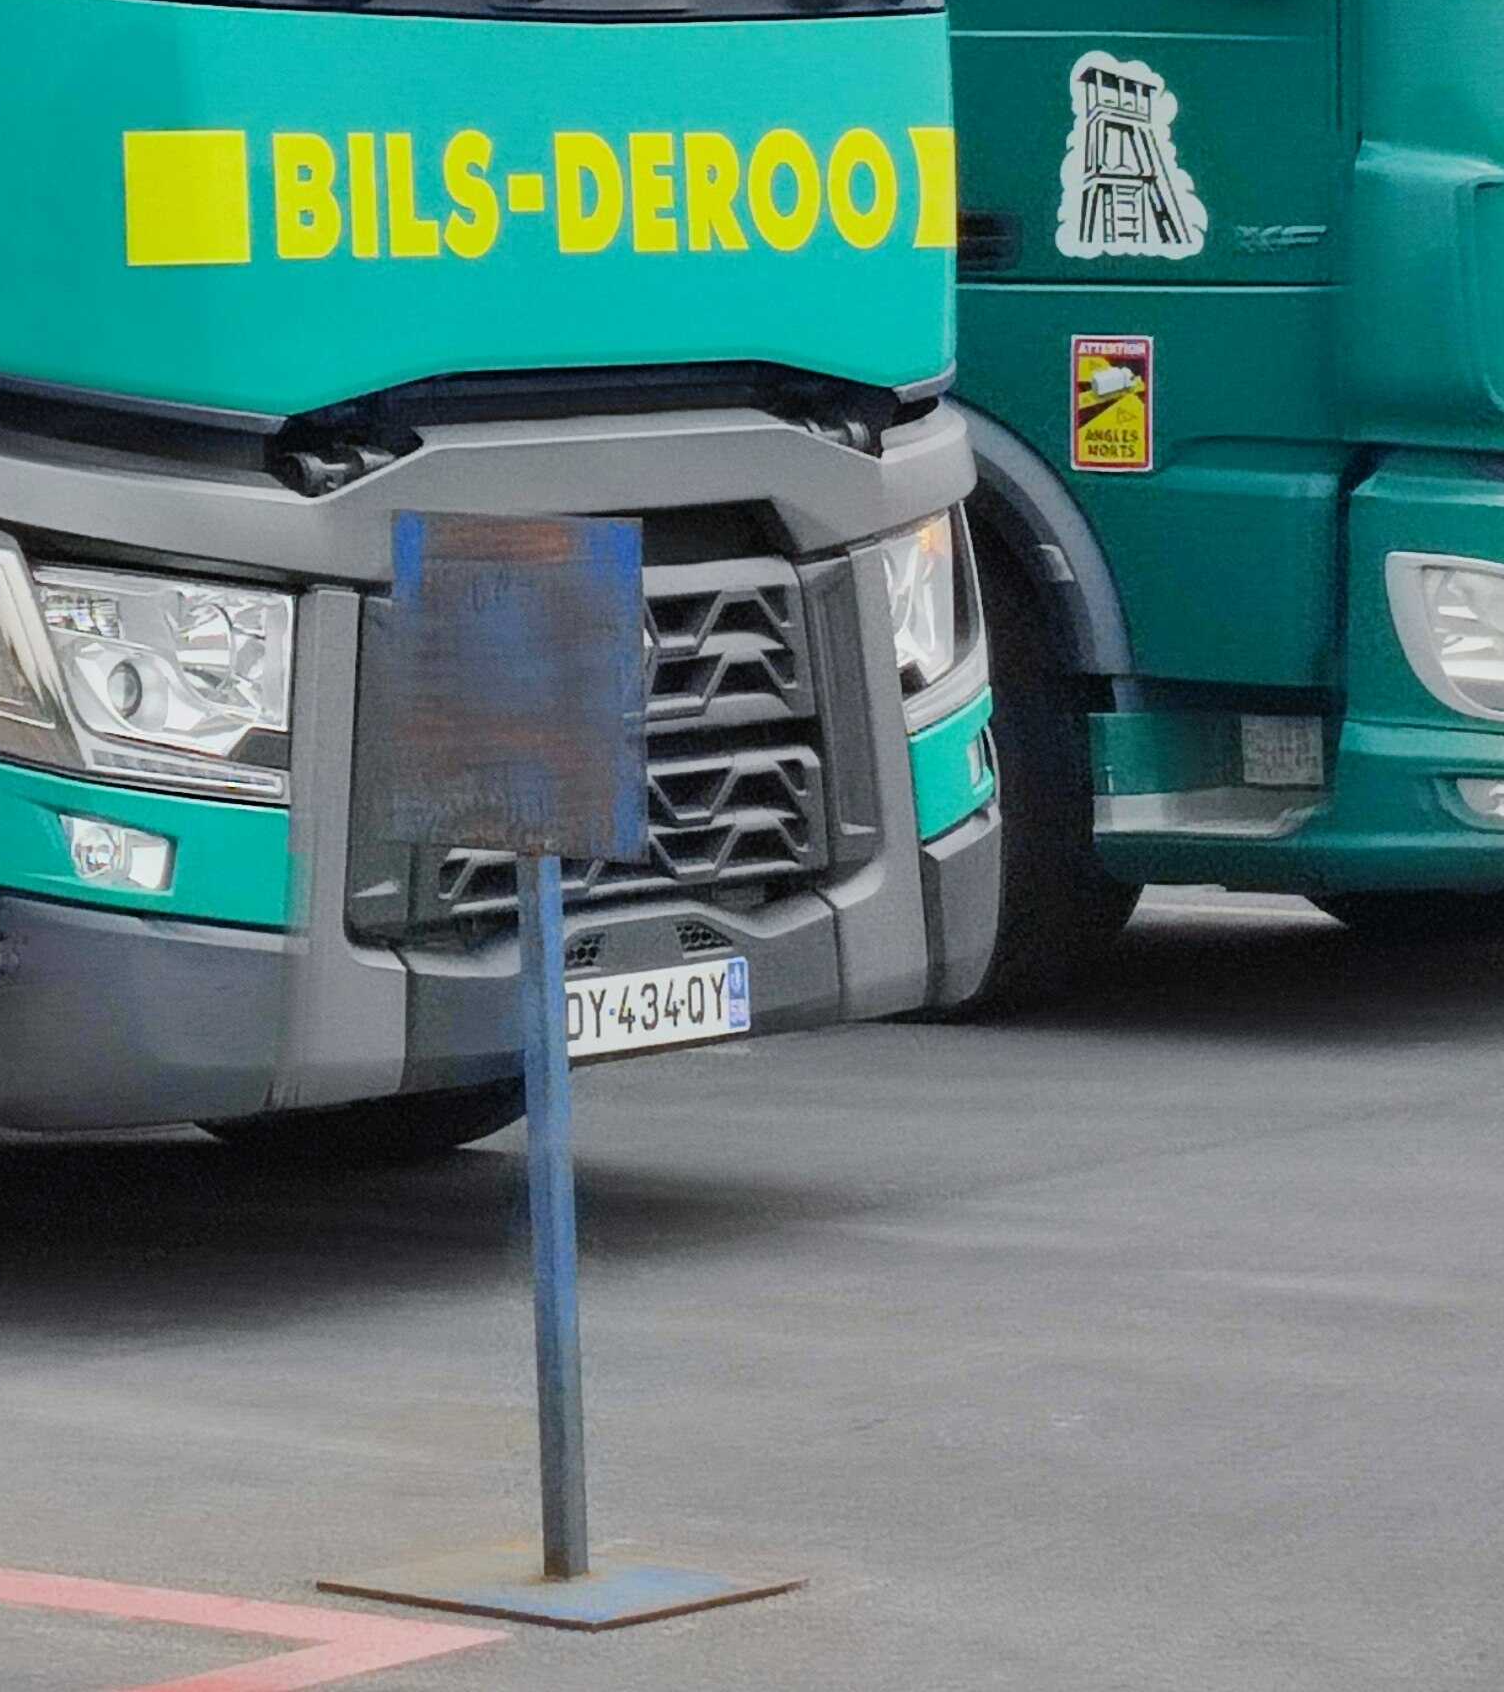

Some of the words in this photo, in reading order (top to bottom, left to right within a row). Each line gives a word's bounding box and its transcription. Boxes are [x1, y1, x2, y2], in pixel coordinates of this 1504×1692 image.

[273, 127, 898, 260] BILS-DEROO
[1085, 428, 1138, 441] ANGLES
[1088, 444, 1135, 457] MORTS
